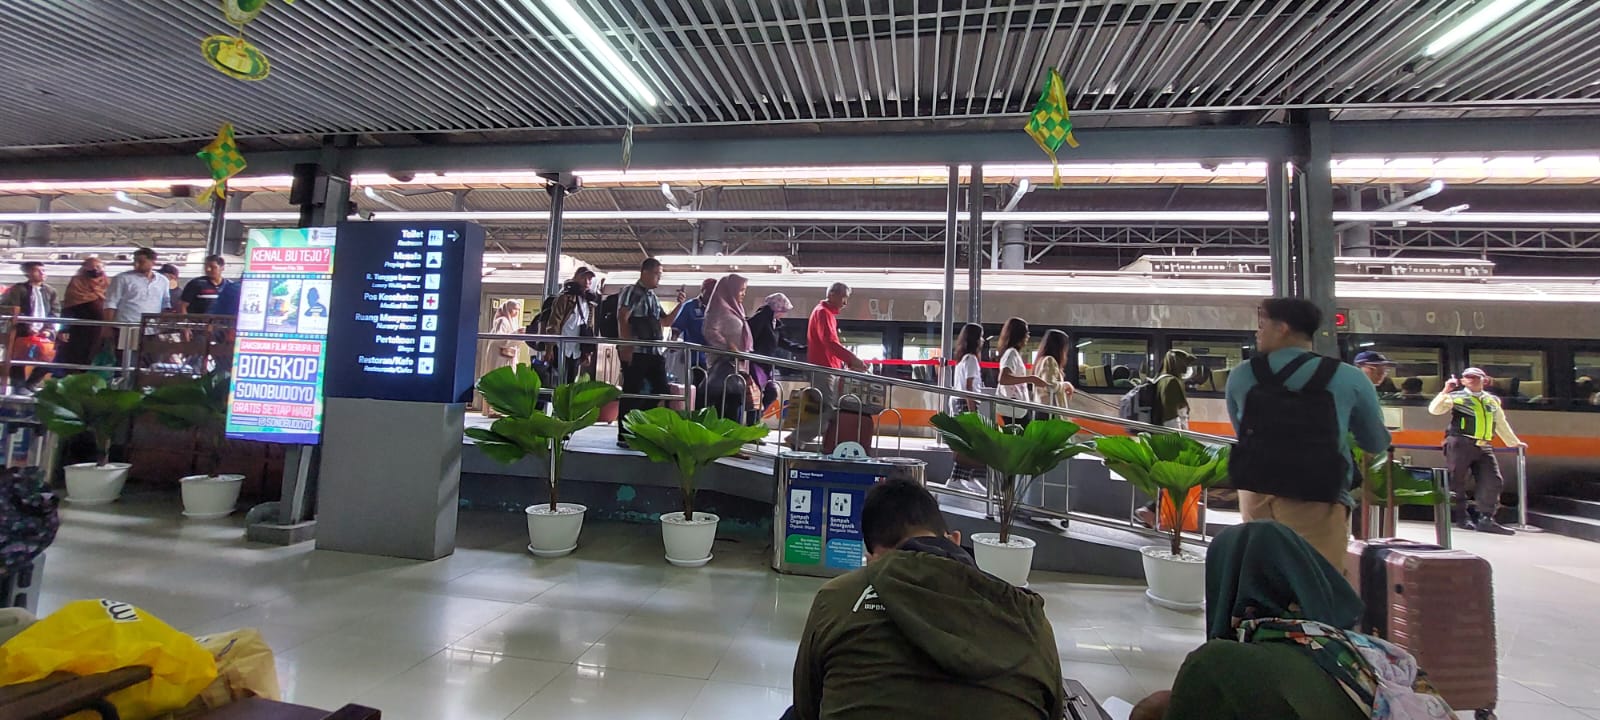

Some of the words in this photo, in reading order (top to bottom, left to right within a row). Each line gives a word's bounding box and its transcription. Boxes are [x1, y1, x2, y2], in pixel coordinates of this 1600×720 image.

[401, 229, 424, 238] Toilet
[251, 249, 283, 262] KENAL
[284, 249, 298, 262] BU
[364, 292, 377, 300] Pos
[355, 313, 379, 323] Ruang
[271, 342, 288, 351] FILM
[237, 355, 318, 380] BIOSKOP
[235, 382, 314, 402] SONOBUDOYO
[232, 402, 262, 414] GRATIS
[262, 403, 291, 416] SETIAP
[291, 405, 313, 418] HARI
